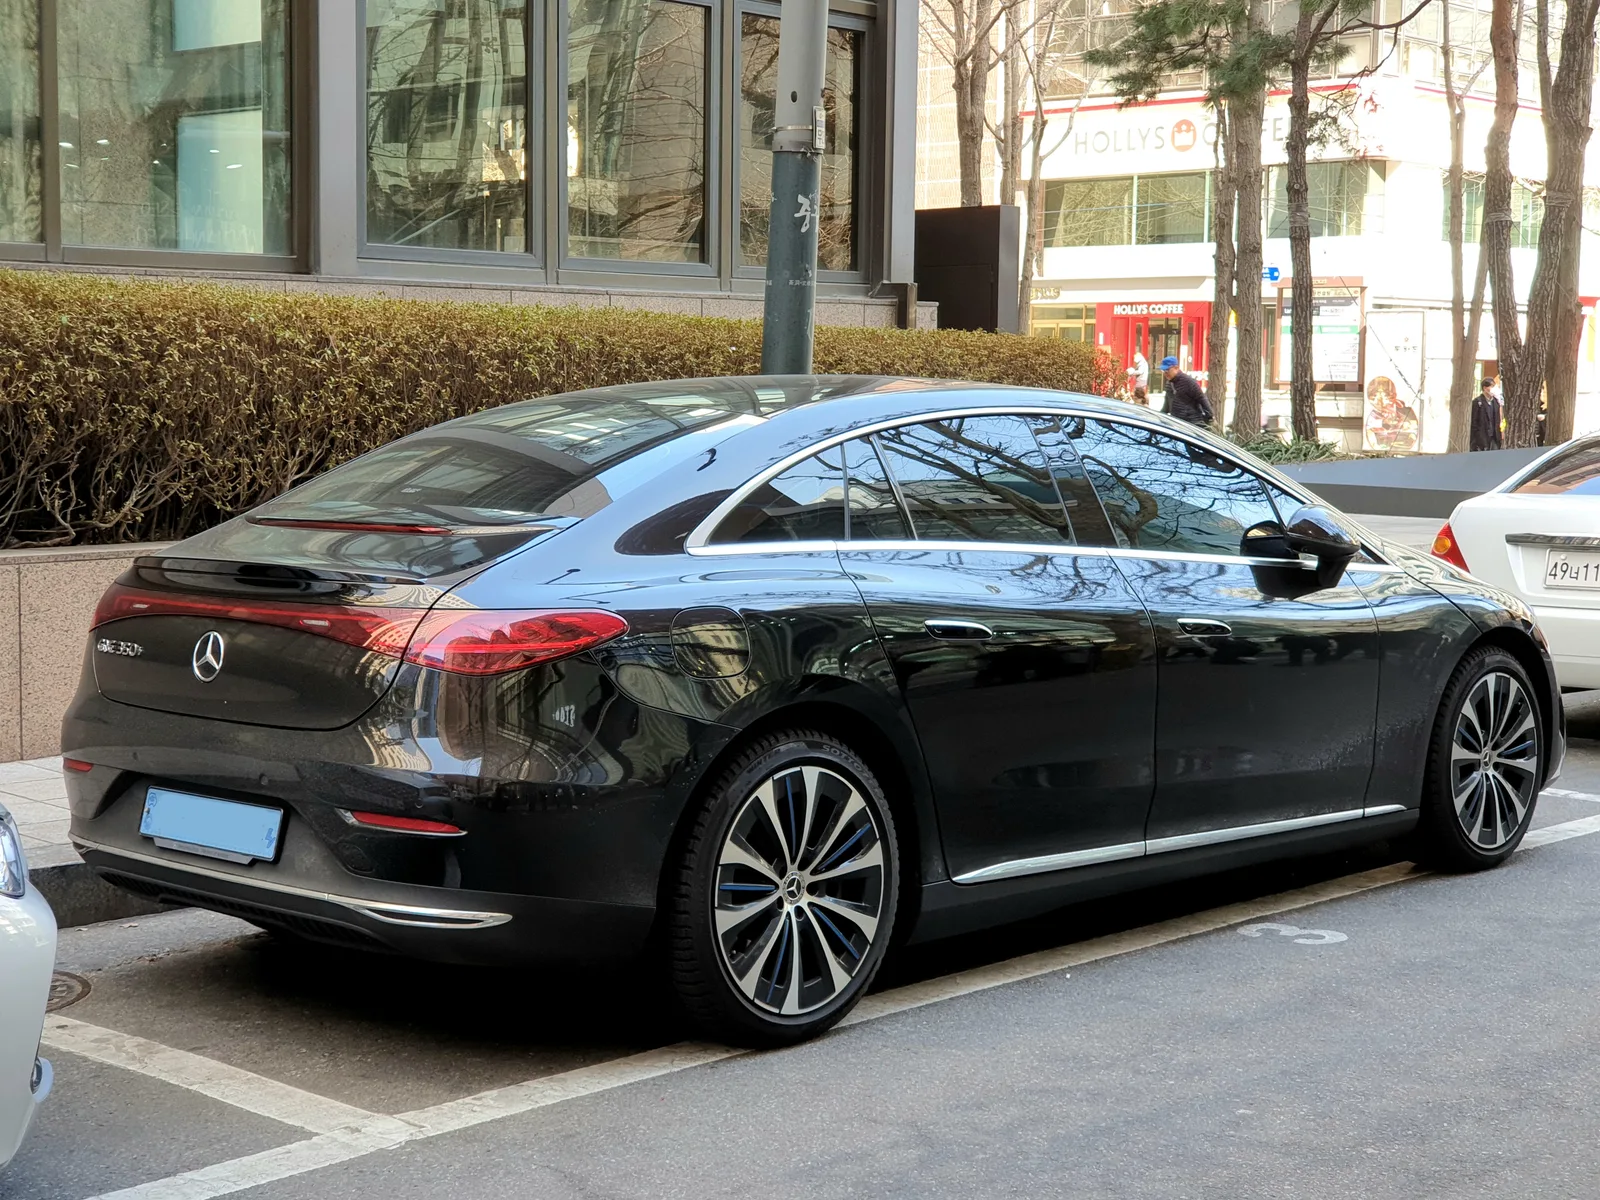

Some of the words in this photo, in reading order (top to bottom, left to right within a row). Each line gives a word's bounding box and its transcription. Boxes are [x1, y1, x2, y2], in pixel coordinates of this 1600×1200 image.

[1074, 126, 1165, 155] HOLLYS
[1113, 304, 1148, 315] HOLLYS
[1149, 303, 1184, 314] COFFEE
